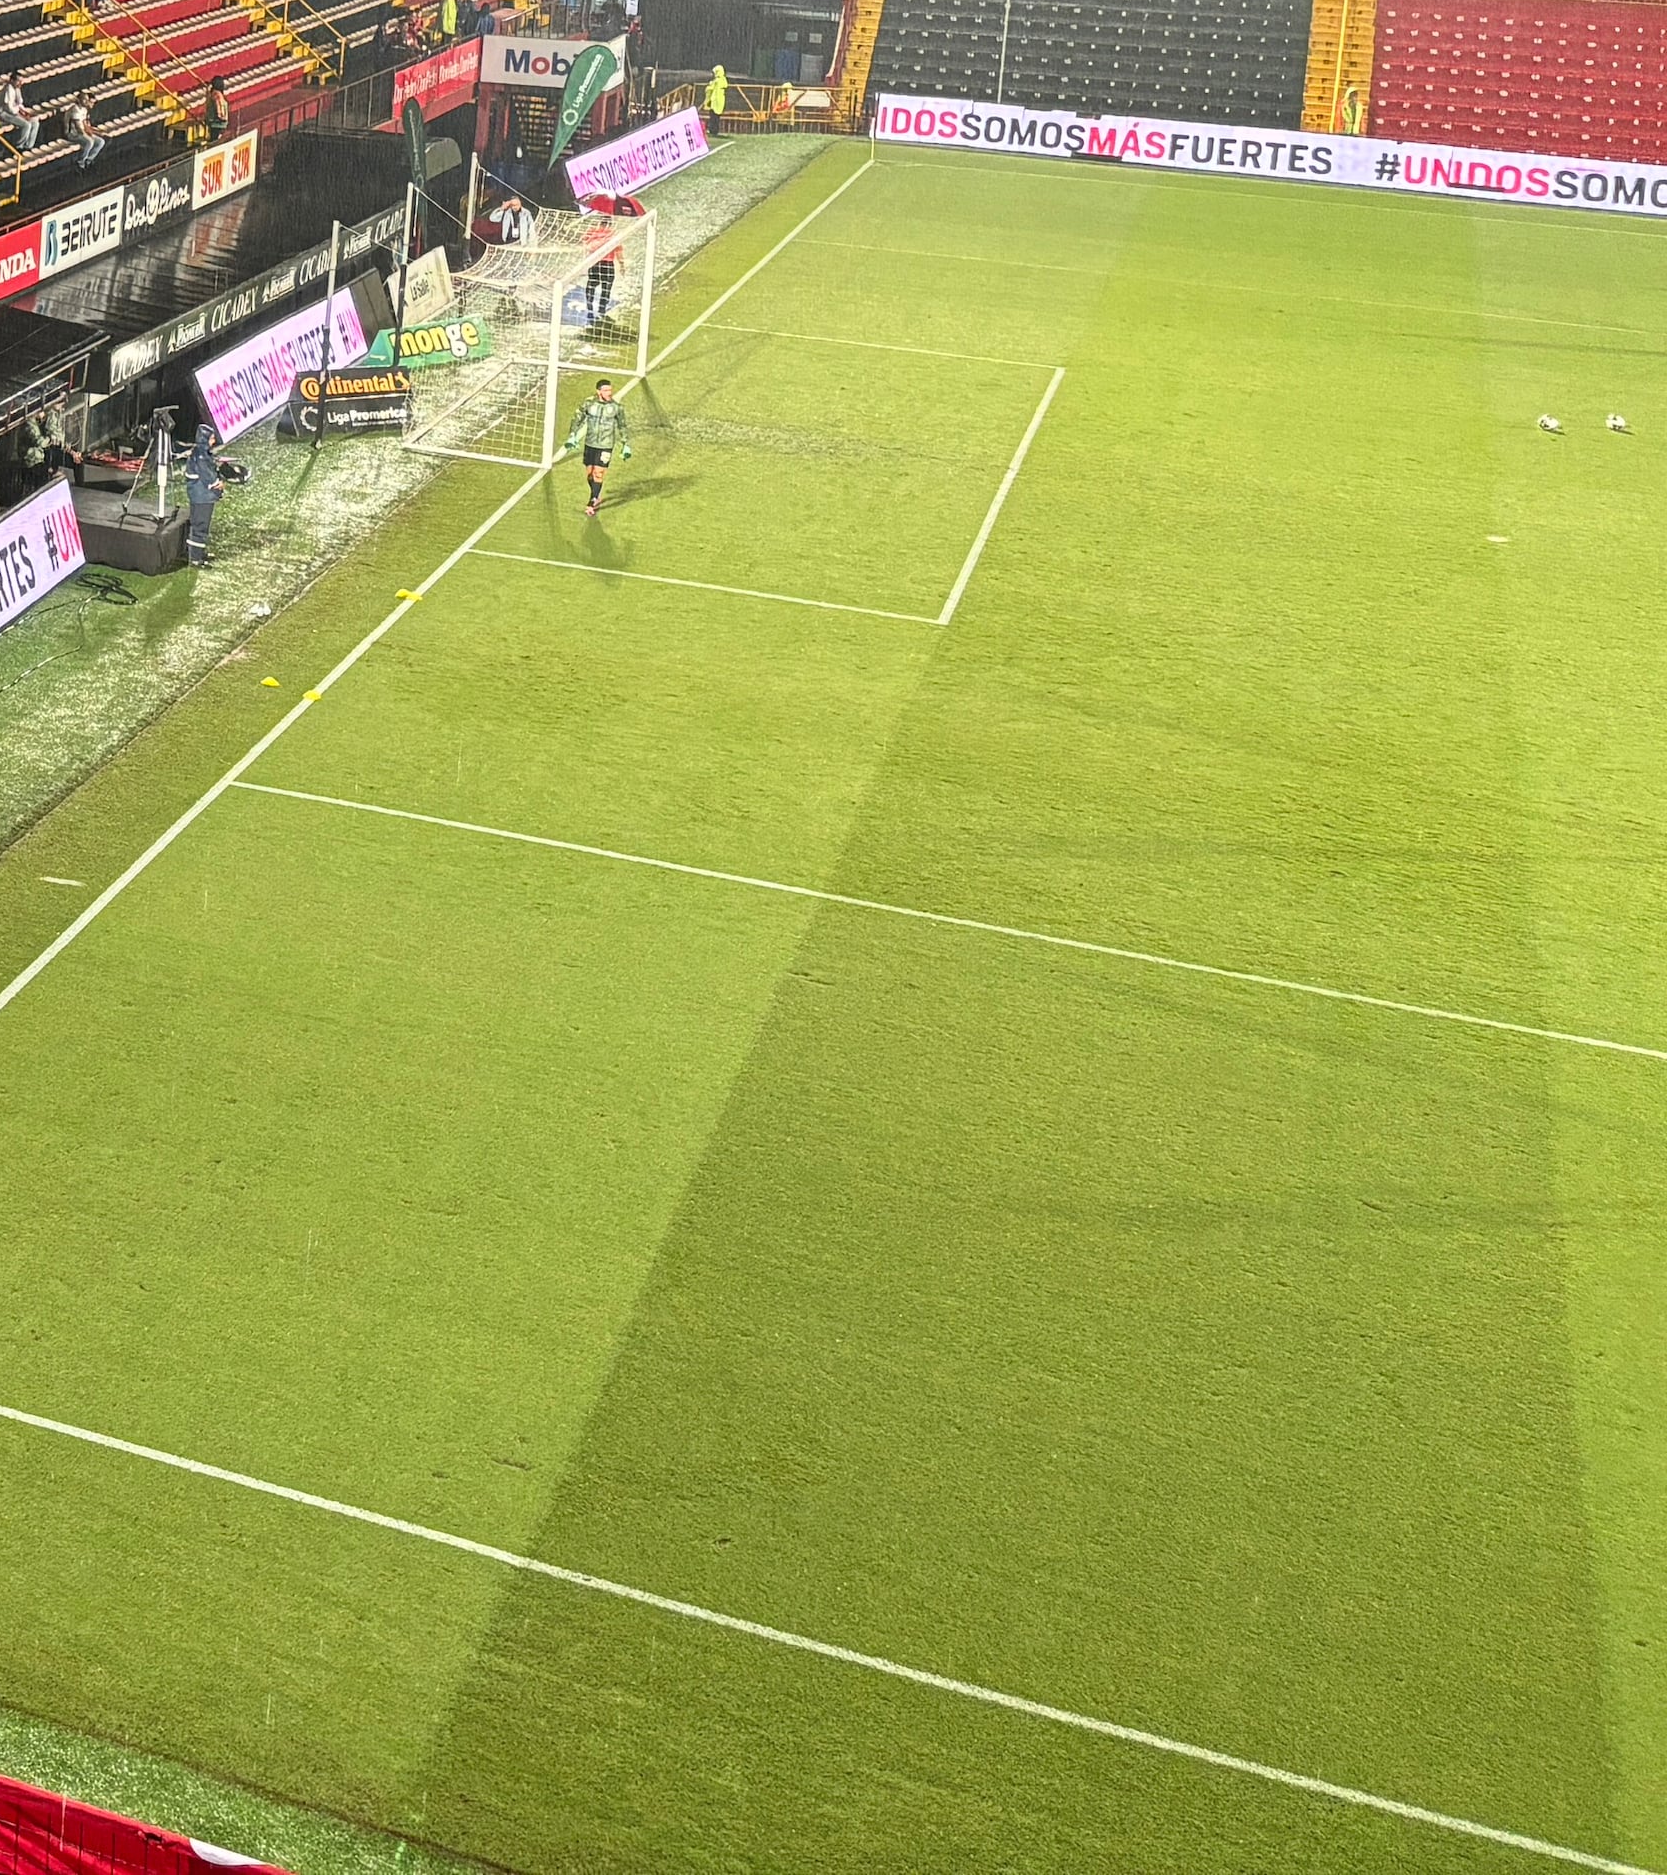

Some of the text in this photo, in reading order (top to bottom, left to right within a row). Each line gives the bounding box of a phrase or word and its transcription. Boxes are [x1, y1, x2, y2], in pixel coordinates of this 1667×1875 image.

[505, 48, 575, 76] Mob
[201, 159, 223, 199] SUR
[230, 147, 250, 185] SUR
[124, 178, 190, 231] Dos Pinos
[61, 202, 118, 256] BEIRUTE
[389, 322, 480, 358] monge
[300, 373, 397, 401] Cotinental
[328, 411, 350, 426] Liga
